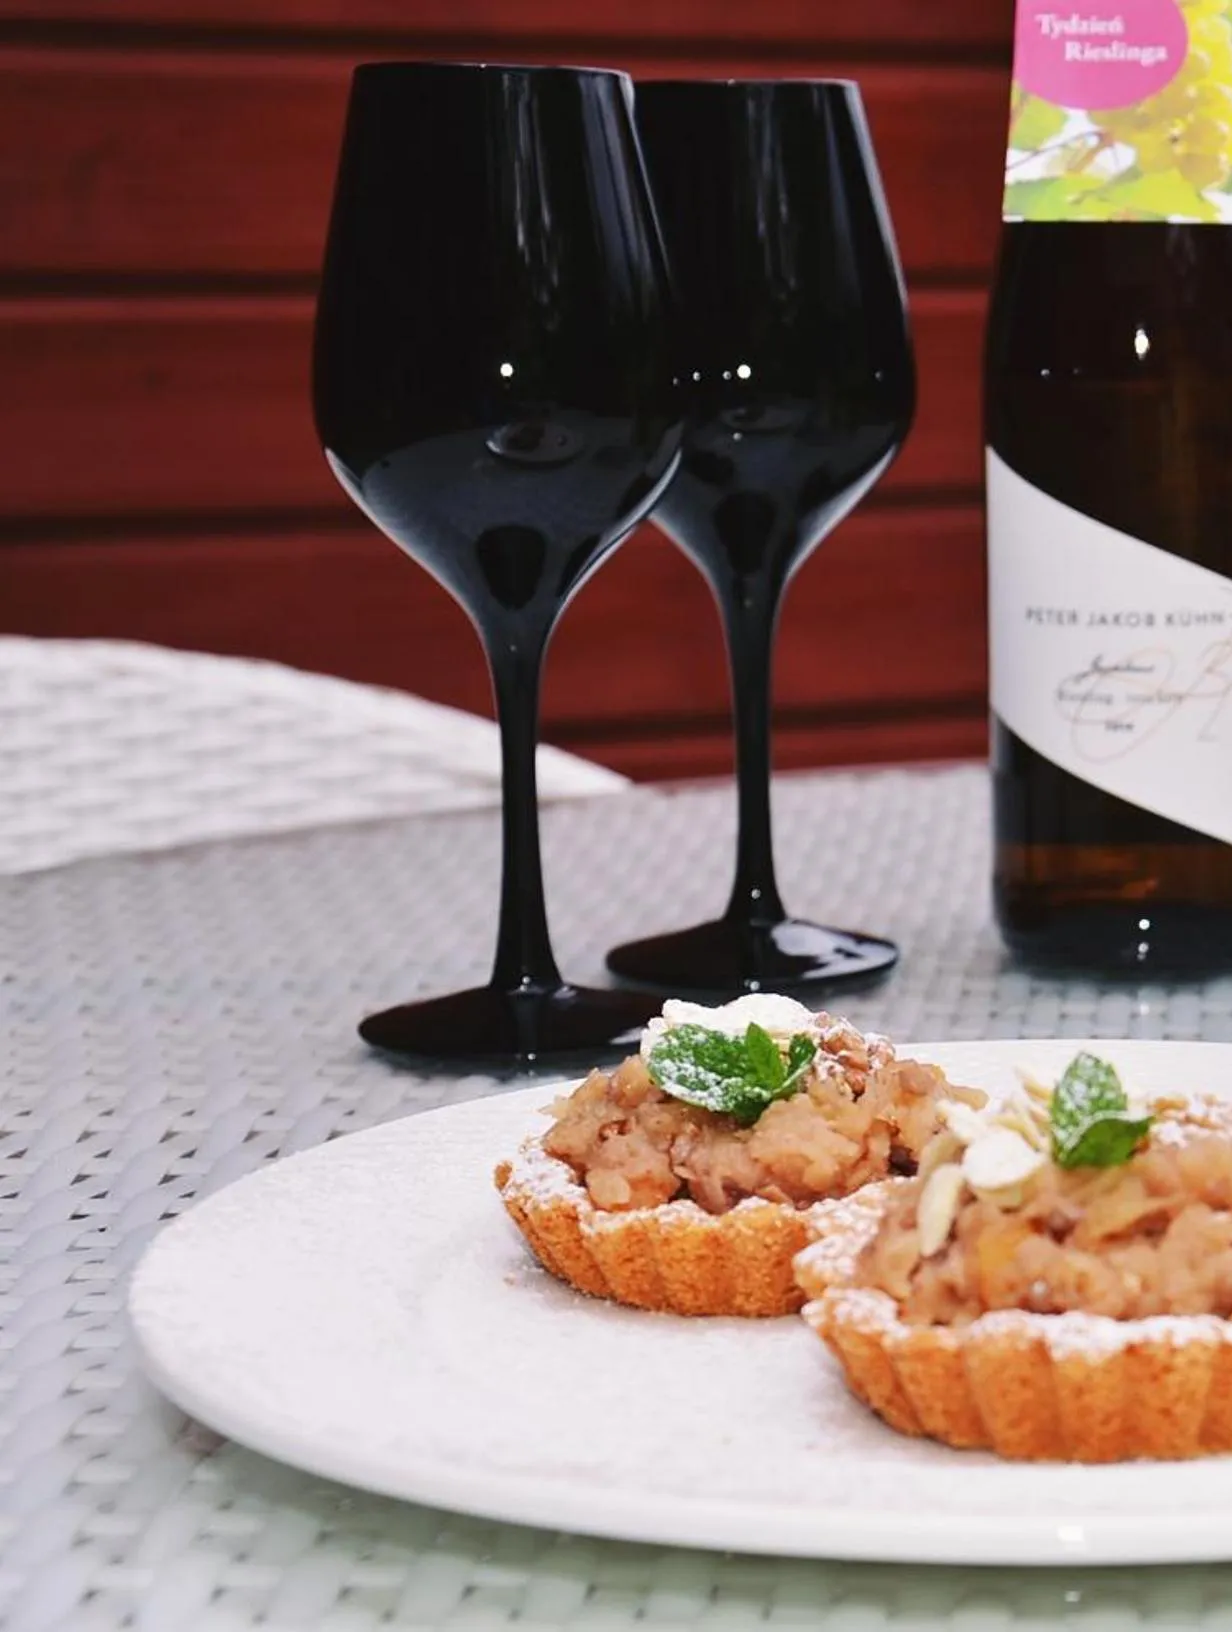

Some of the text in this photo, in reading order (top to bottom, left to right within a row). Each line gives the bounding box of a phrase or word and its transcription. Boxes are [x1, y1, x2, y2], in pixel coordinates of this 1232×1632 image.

[1035, 14, 1124, 39] Tydzień
[1064, 41, 1168, 67] Rieslinga
[1025, 606, 1079, 625] PETER
[1086, 610, 1157, 628] JAKOB
